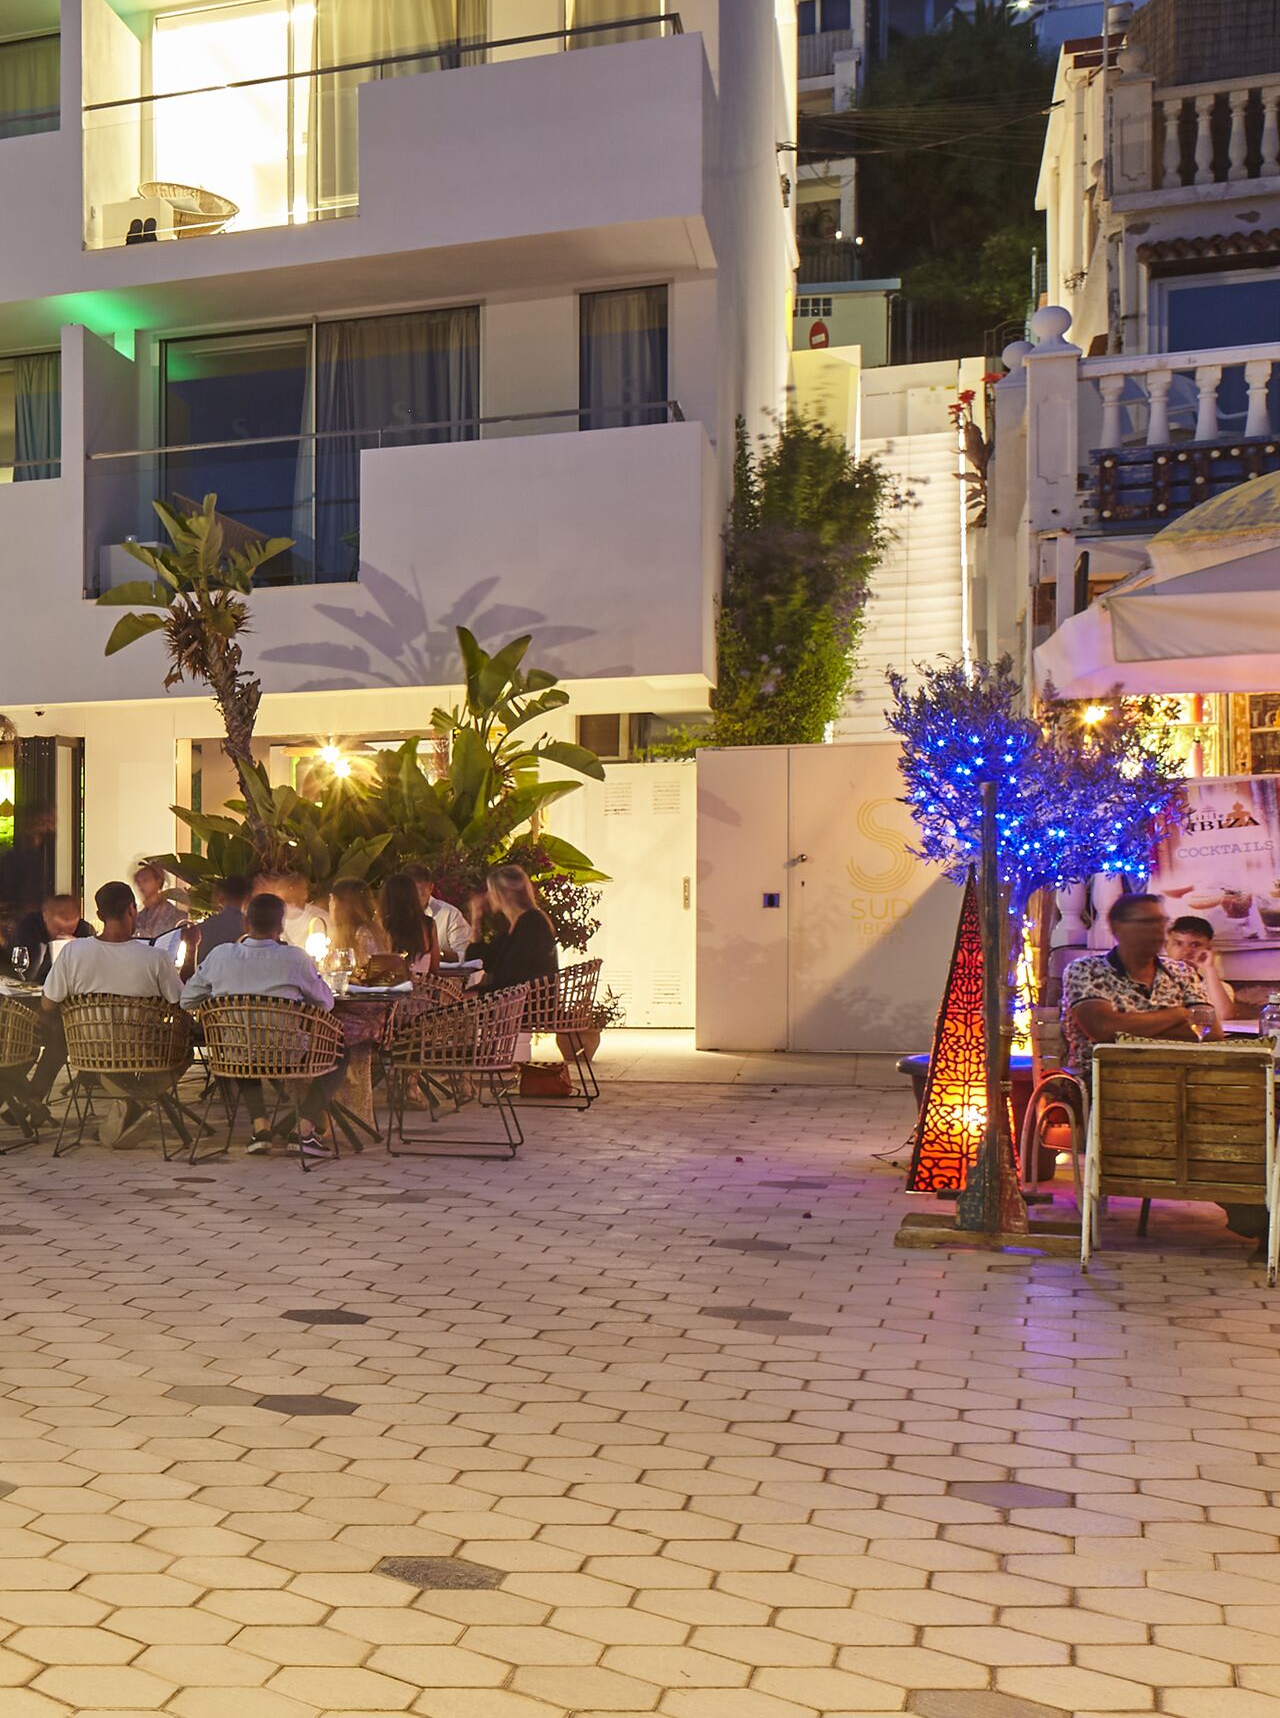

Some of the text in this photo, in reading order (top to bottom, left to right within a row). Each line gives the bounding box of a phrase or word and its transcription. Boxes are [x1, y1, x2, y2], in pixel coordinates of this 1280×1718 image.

[1191, 816, 1260, 832] IBIZA
[1177, 840, 1274, 859] COCKTAILS
[850, 898, 912, 920] SUD
[858, 922, 903, 935] IBIZA
